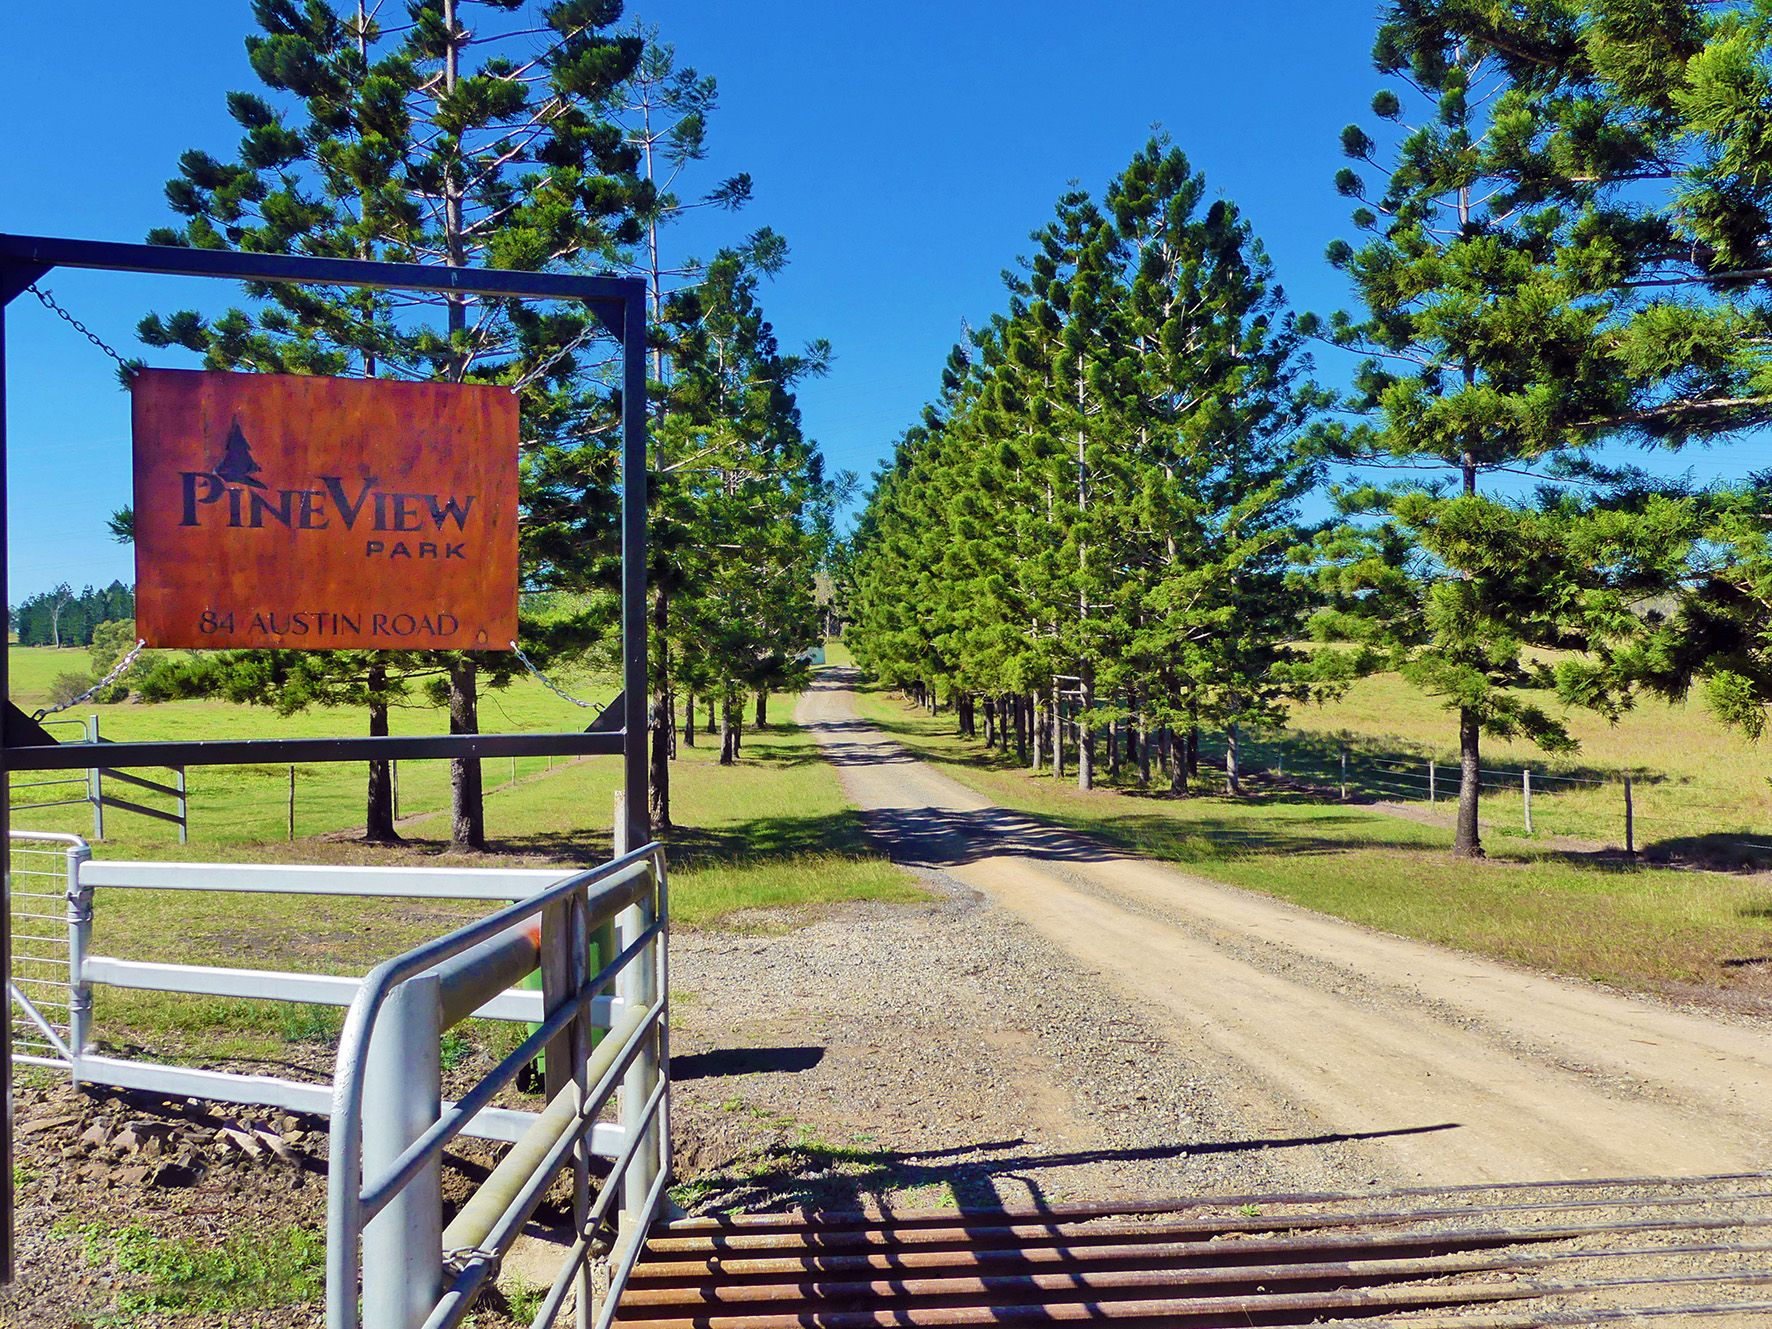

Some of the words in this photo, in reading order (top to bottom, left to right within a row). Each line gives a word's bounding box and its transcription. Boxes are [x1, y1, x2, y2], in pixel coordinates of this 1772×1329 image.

[366, 540, 467, 560] PARK
[200, 610, 235, 635] 84
[251, 611, 362, 636] AUSTIN
[372, 613, 460, 637] ROAD
